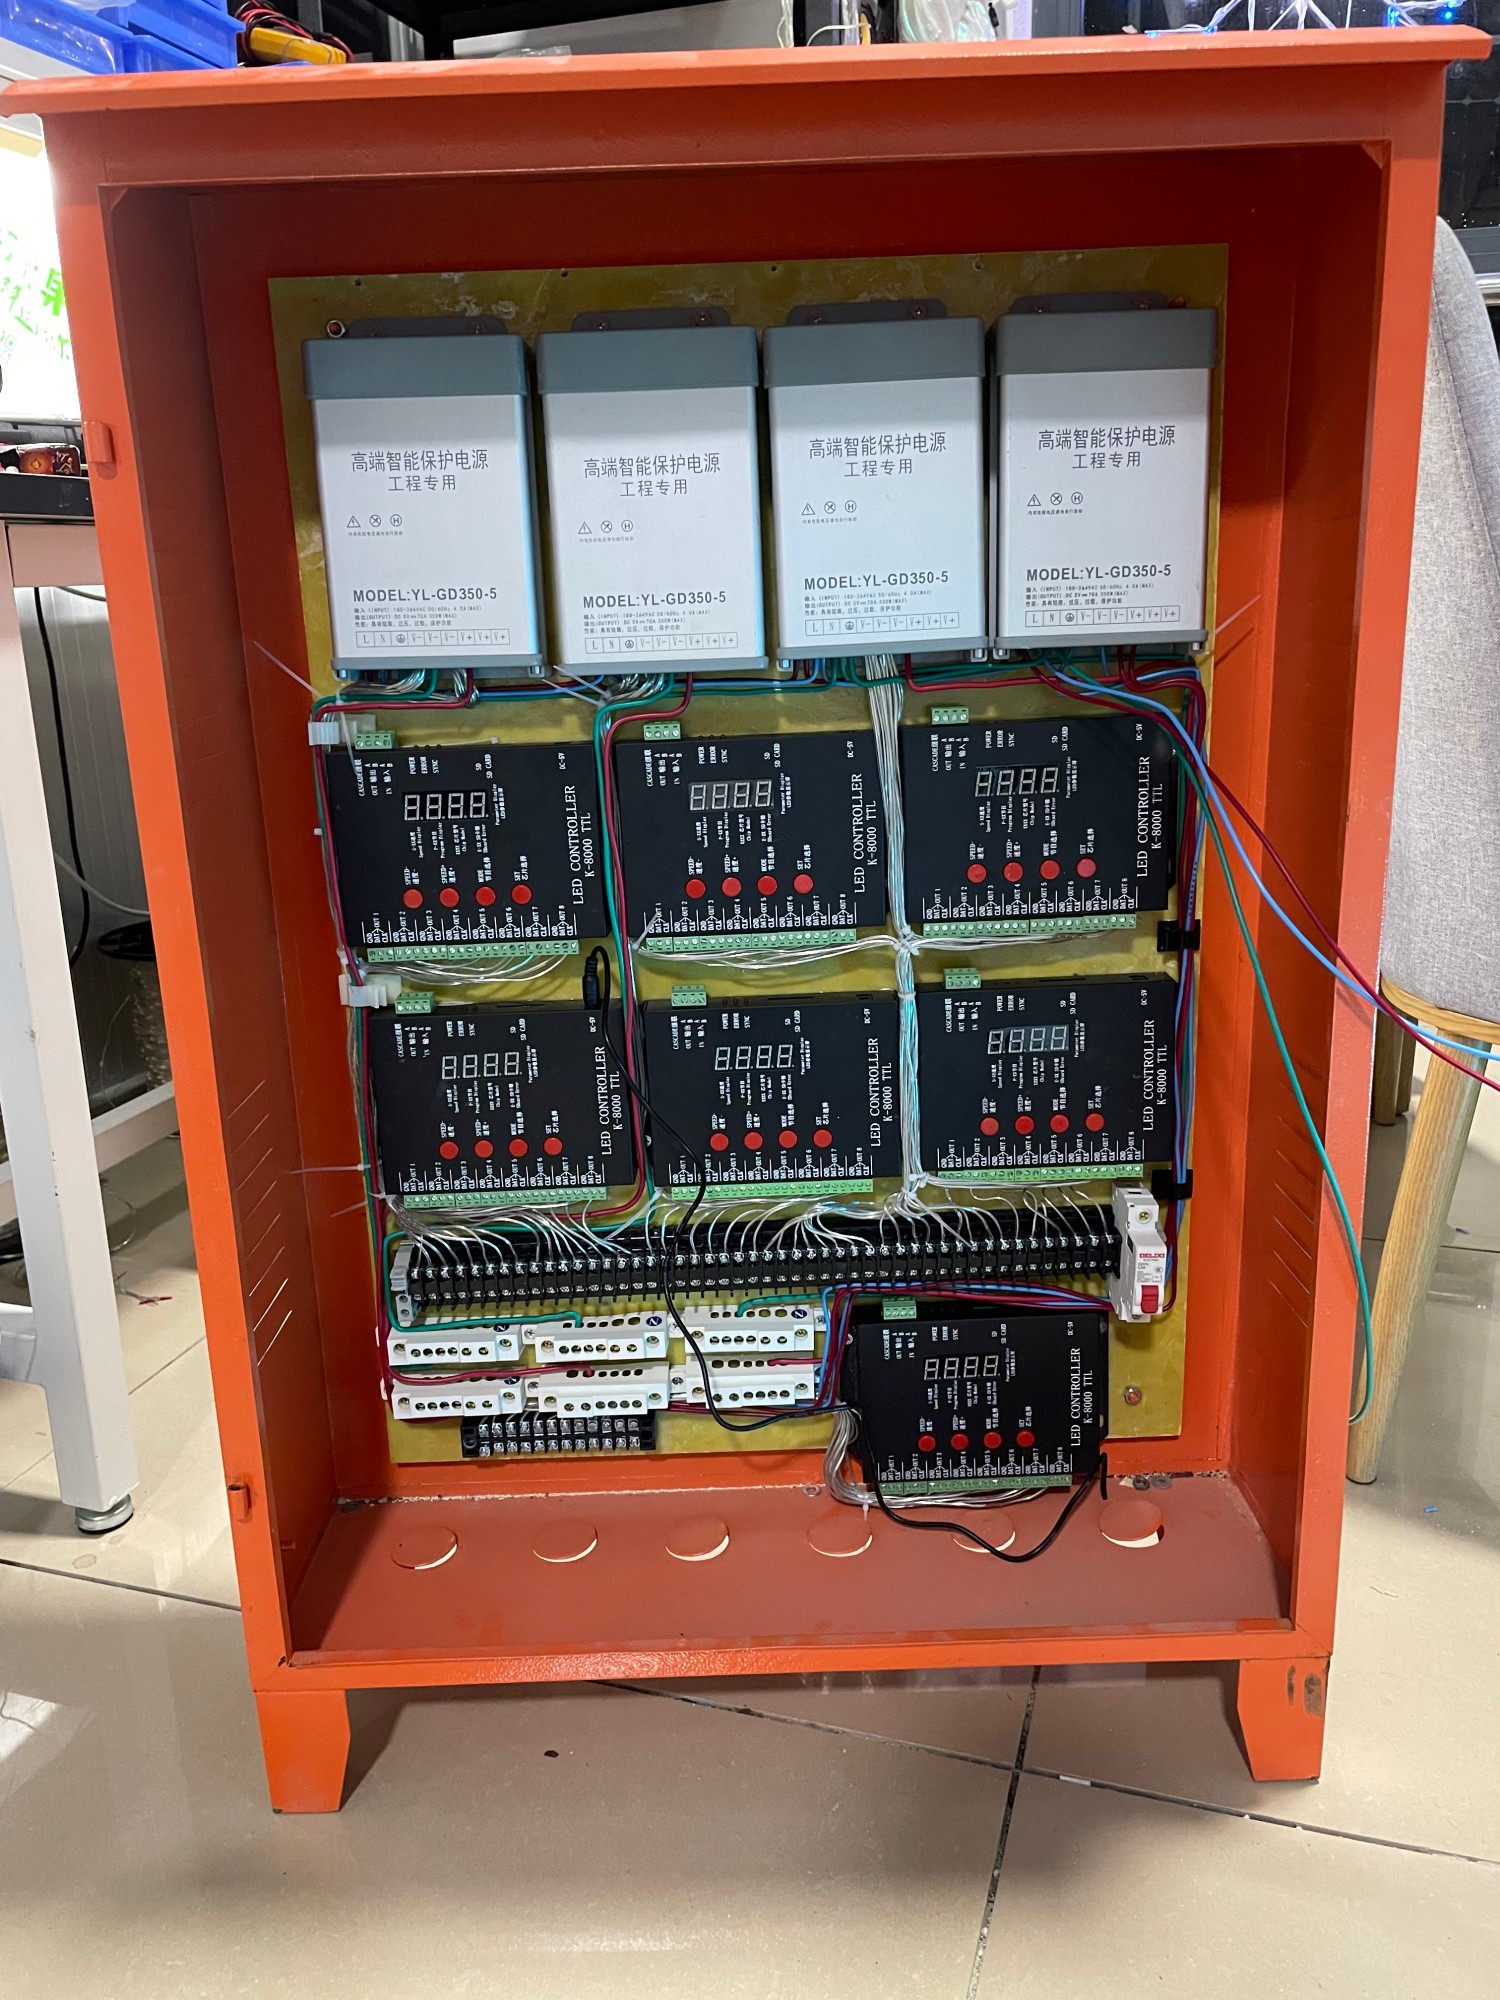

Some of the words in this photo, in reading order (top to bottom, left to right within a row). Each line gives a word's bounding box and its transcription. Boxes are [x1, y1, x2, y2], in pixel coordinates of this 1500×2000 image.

[809, 432, 946, 459] 高端智能保护电源
[1038, 425, 1175, 450] 高端智能保护电源
[351, 450, 488, 472] 高端智能保护电源
[584, 453, 720, 478] 高端智能保护电源
[844, 459, 912, 477] 工程专用
[1072, 452, 1140, 469] 工程专用
[388, 475, 456, 492] 工程专用
[620, 479, 687, 497] 工程专用
[804, 571, 948, 590] MODEL:YL-GD350-5
[1027, 564, 1171, 581] MODEL:YL-GD350-5
[353, 588, 497, 602] MODEL:YL-GD350-5
[583, 591, 726, 608] MODEL:YL-GD350-5
[1033, 614, 1038, 623] L
[593, 640, 598, 650] L
[1138, 757, 1149, 843] CONTROLLER
[1152, 784, 1162, 803] TTL
[581, 813, 591, 832] TTL
[852, 774, 864, 859] CONTROLLER
[866, 801, 876, 820] TTL
[565, 786, 581, 871] CONTROLLER
[1151, 810, 1162, 849] K-8000
[582, 839, 594, 877] K-8000
[867, 827, 877, 865] K-8000
[1137, 851, 1147, 877] LED
[572, 879, 583, 904] LED
[854, 867, 865, 893] LED
[1144, 1020, 1154, 1099] CONTROLLER
[1157, 1045, 1167, 1063] TTL
[610, 1071, 620, 1089] TTL
[868, 1038, 880, 1116] CONTROLLER
[882, 1063, 891, 1081] TTL
[595, 1047, 609, 1124] CONTROLLER
[1157, 1069, 1166, 1105] K-8000
[611, 1095, 622, 1130] K-8000
[882, 1086, 892, 1121] K-8000
[1143, 1106, 1153, 1130] LED
[601, 1131, 611, 1155] LED
[870, 1123, 880, 1146] LED
[1071, 1348, 1080, 1419] CONTROLLER
[1083, 1370, 1092, 1386] TTL
[1083, 1392, 1092, 1423] K-8000
[1071, 1425, 1080, 1446] LED
